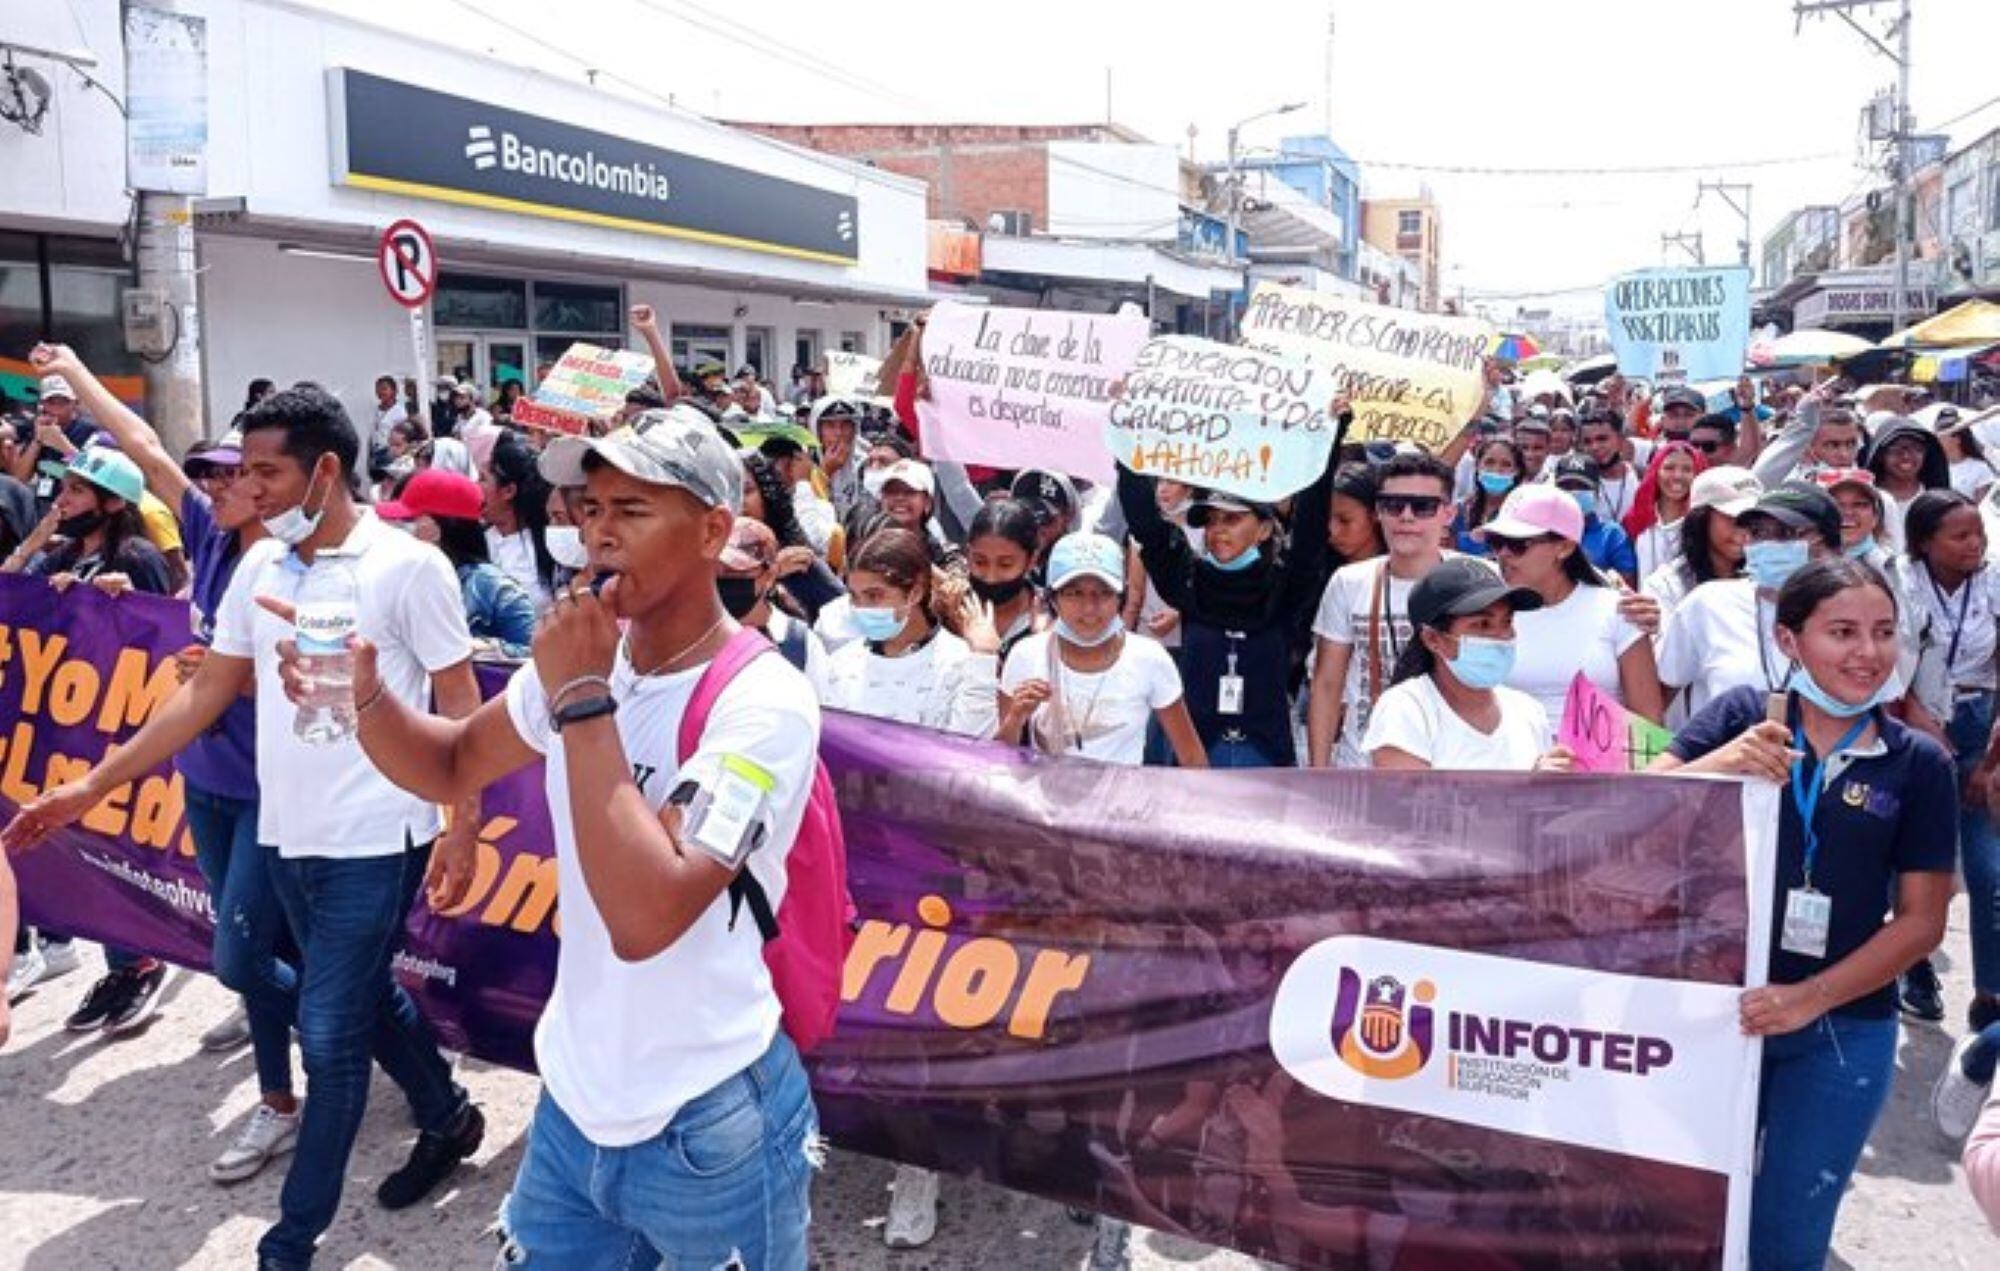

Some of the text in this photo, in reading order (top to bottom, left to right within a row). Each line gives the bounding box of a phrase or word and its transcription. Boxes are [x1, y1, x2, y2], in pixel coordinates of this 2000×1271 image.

[501, 132, 669, 200] Bancolombia
[1615, 275, 1726, 311] OPERACIONES
[975, 311, 1102, 364] La clave de la
[1110, 399, 1232, 444] CALIDAD
[1448, 1010, 1674, 1076] INFOTEP
